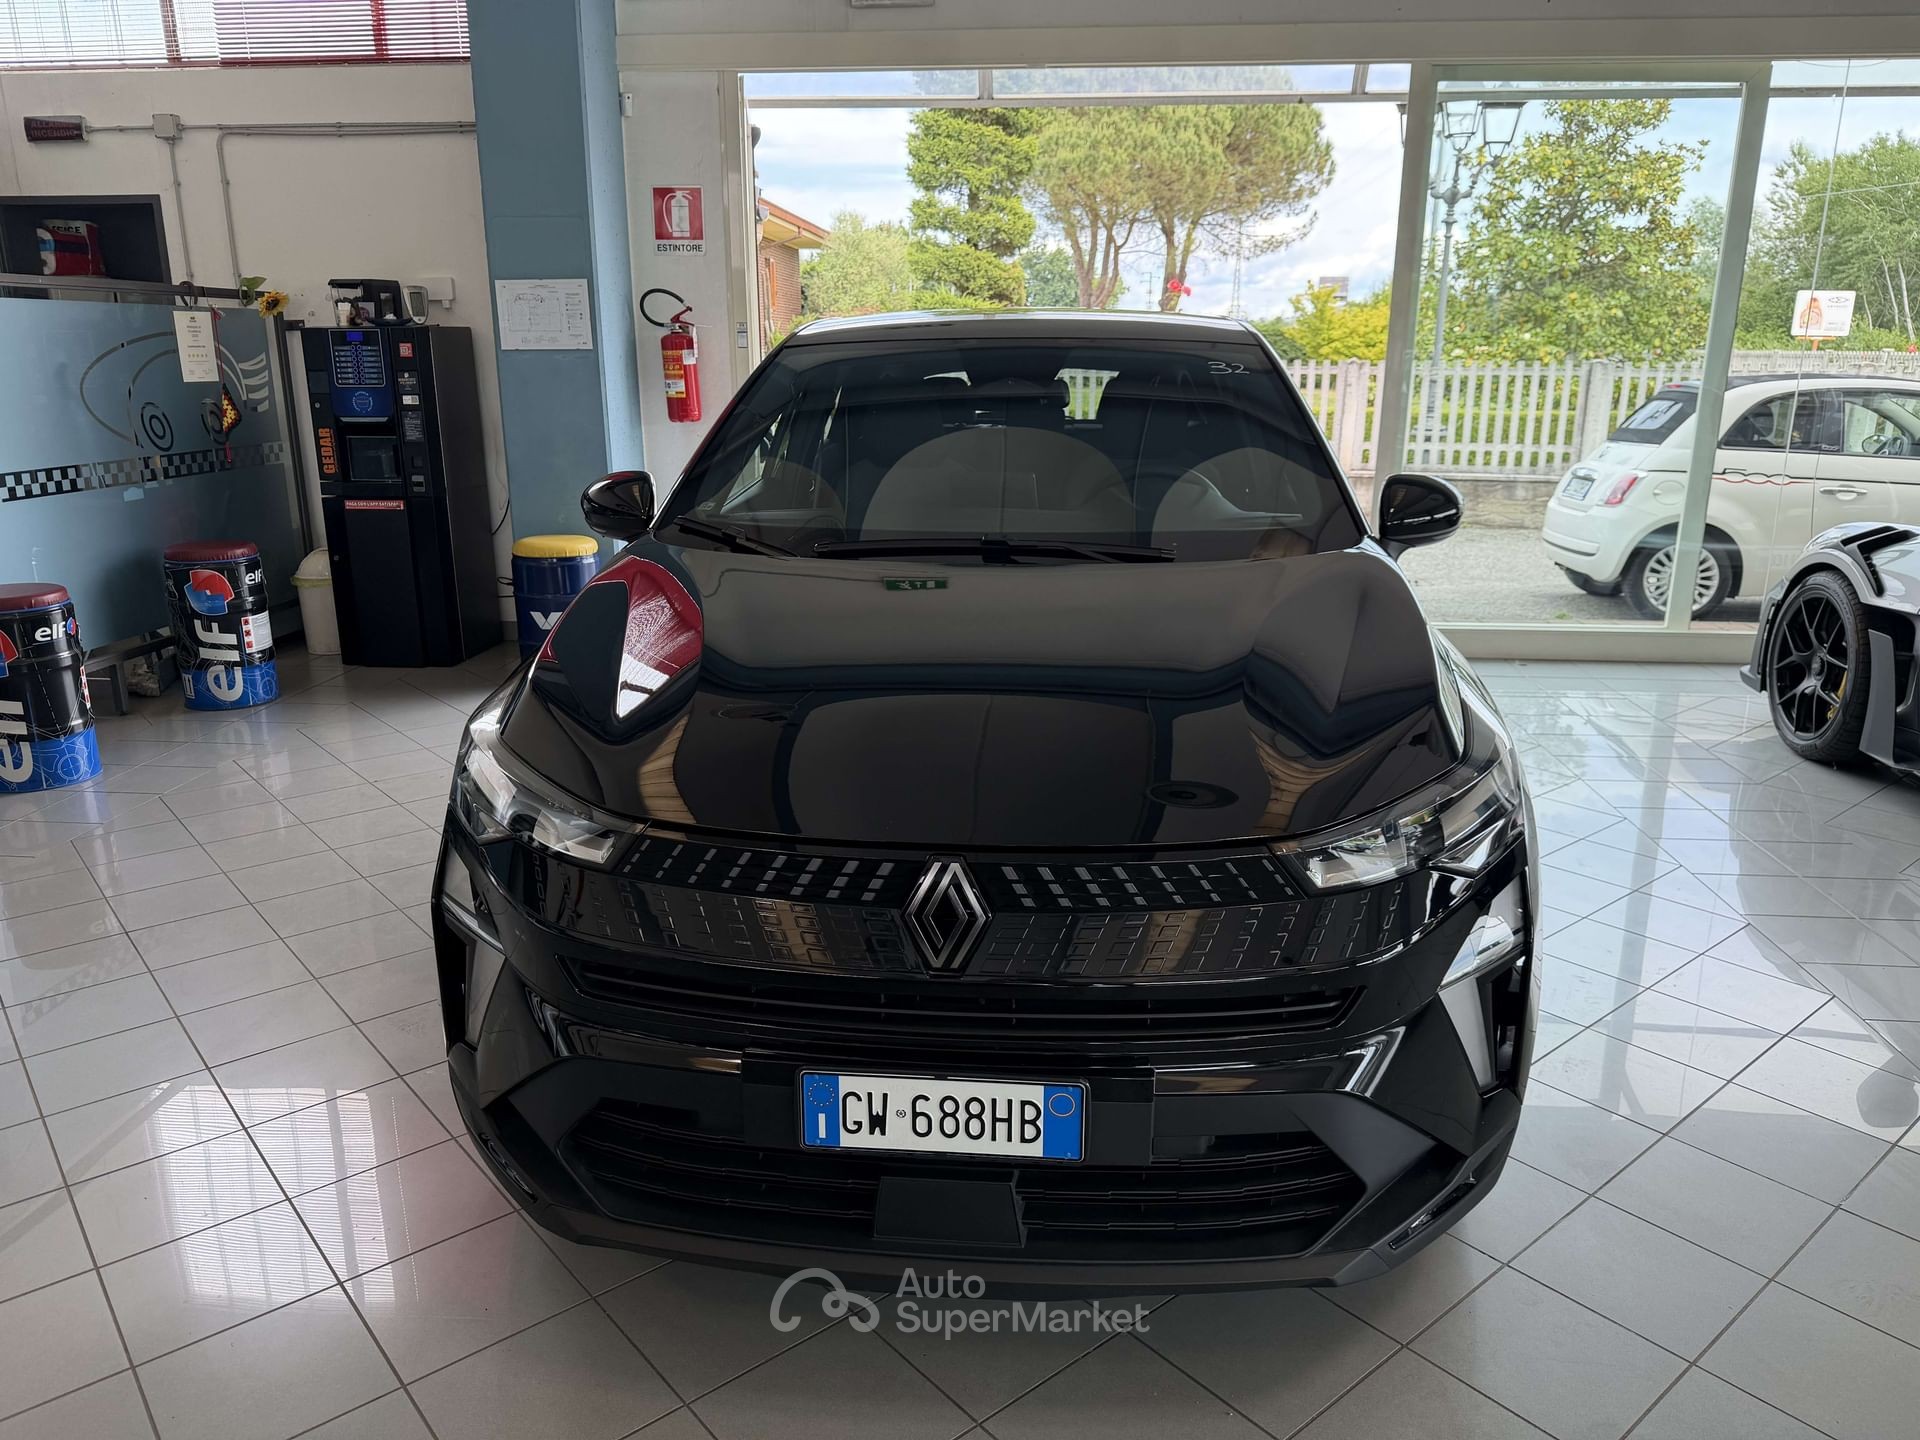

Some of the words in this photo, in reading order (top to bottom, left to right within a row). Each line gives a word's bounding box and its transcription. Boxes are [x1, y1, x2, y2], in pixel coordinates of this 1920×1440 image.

[656, 243, 704, 253] ESTINTORE
[1207, 361, 1250, 375] 32
[318, 427, 335, 474] GEDAR
[245, 568, 263, 586] elf
[34, 620, 67, 642] elf
[194, 618, 244, 702] elf
[841, 1090, 889, 1137] GW
[911, 1093, 1042, 1145] 688HB
